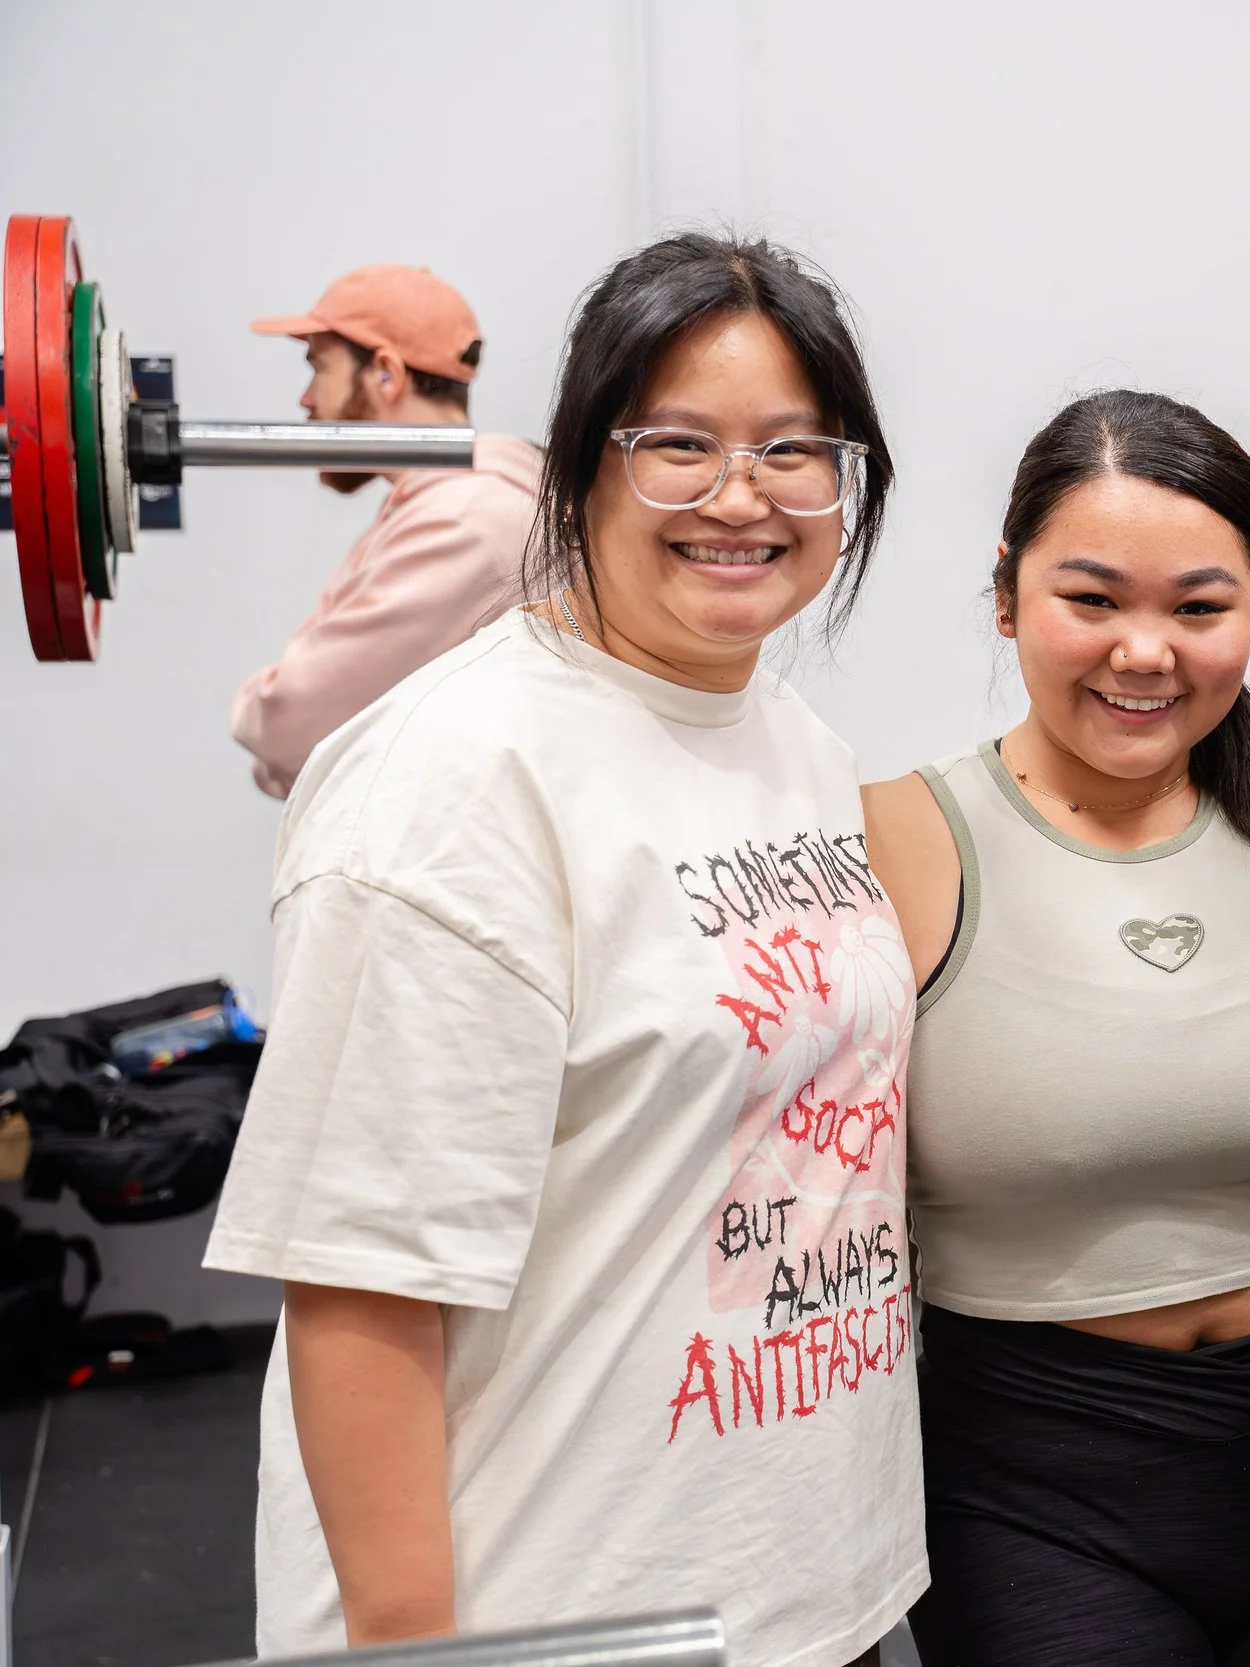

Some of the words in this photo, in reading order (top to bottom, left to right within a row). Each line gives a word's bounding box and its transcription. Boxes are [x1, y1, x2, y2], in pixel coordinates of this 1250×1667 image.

[675, 828, 884, 937] SOMETIME
[715, 923, 831, 1059] ANTI
[715, 1196, 797, 1262] BUT
[764, 1221, 899, 1330] ALWAYS
